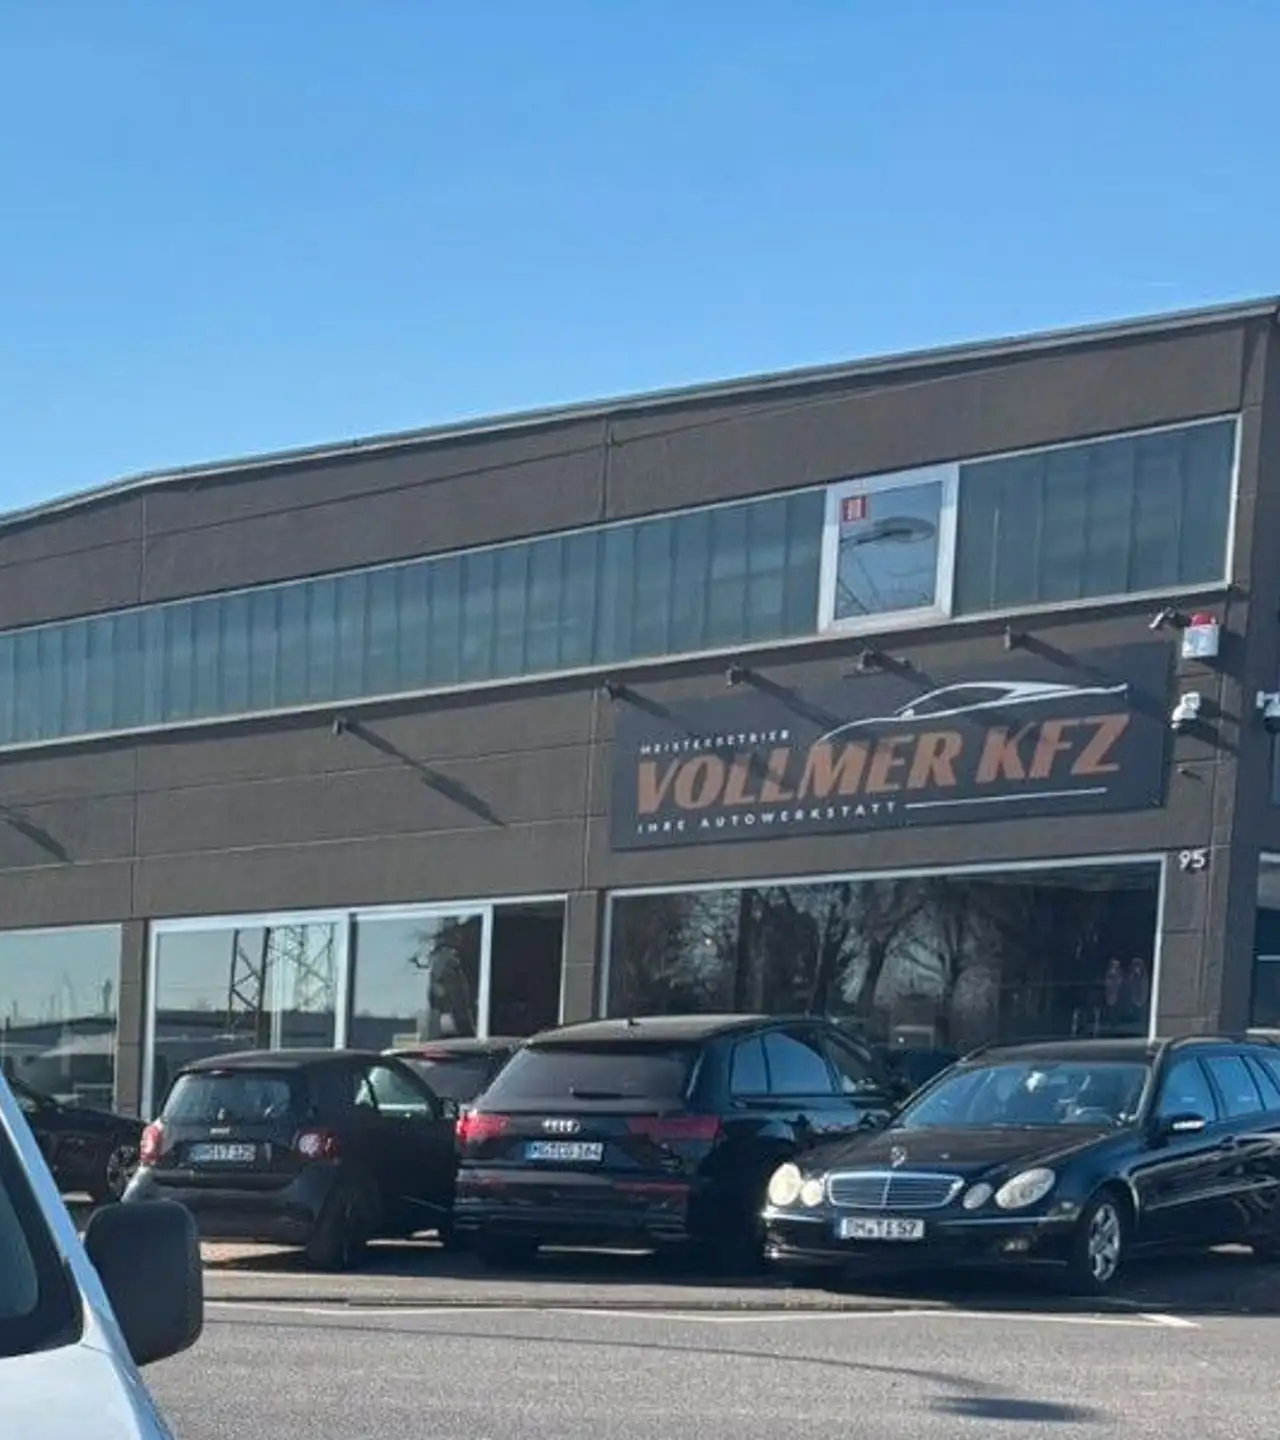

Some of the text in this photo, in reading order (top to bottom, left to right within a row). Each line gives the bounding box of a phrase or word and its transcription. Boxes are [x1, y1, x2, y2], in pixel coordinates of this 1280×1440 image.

[638, 713, 1131, 814] VOLLMER KFZ
[637, 801, 896, 835] IHRE AUTOWERKSTATT
[1178, 851, 1205, 869] 95
